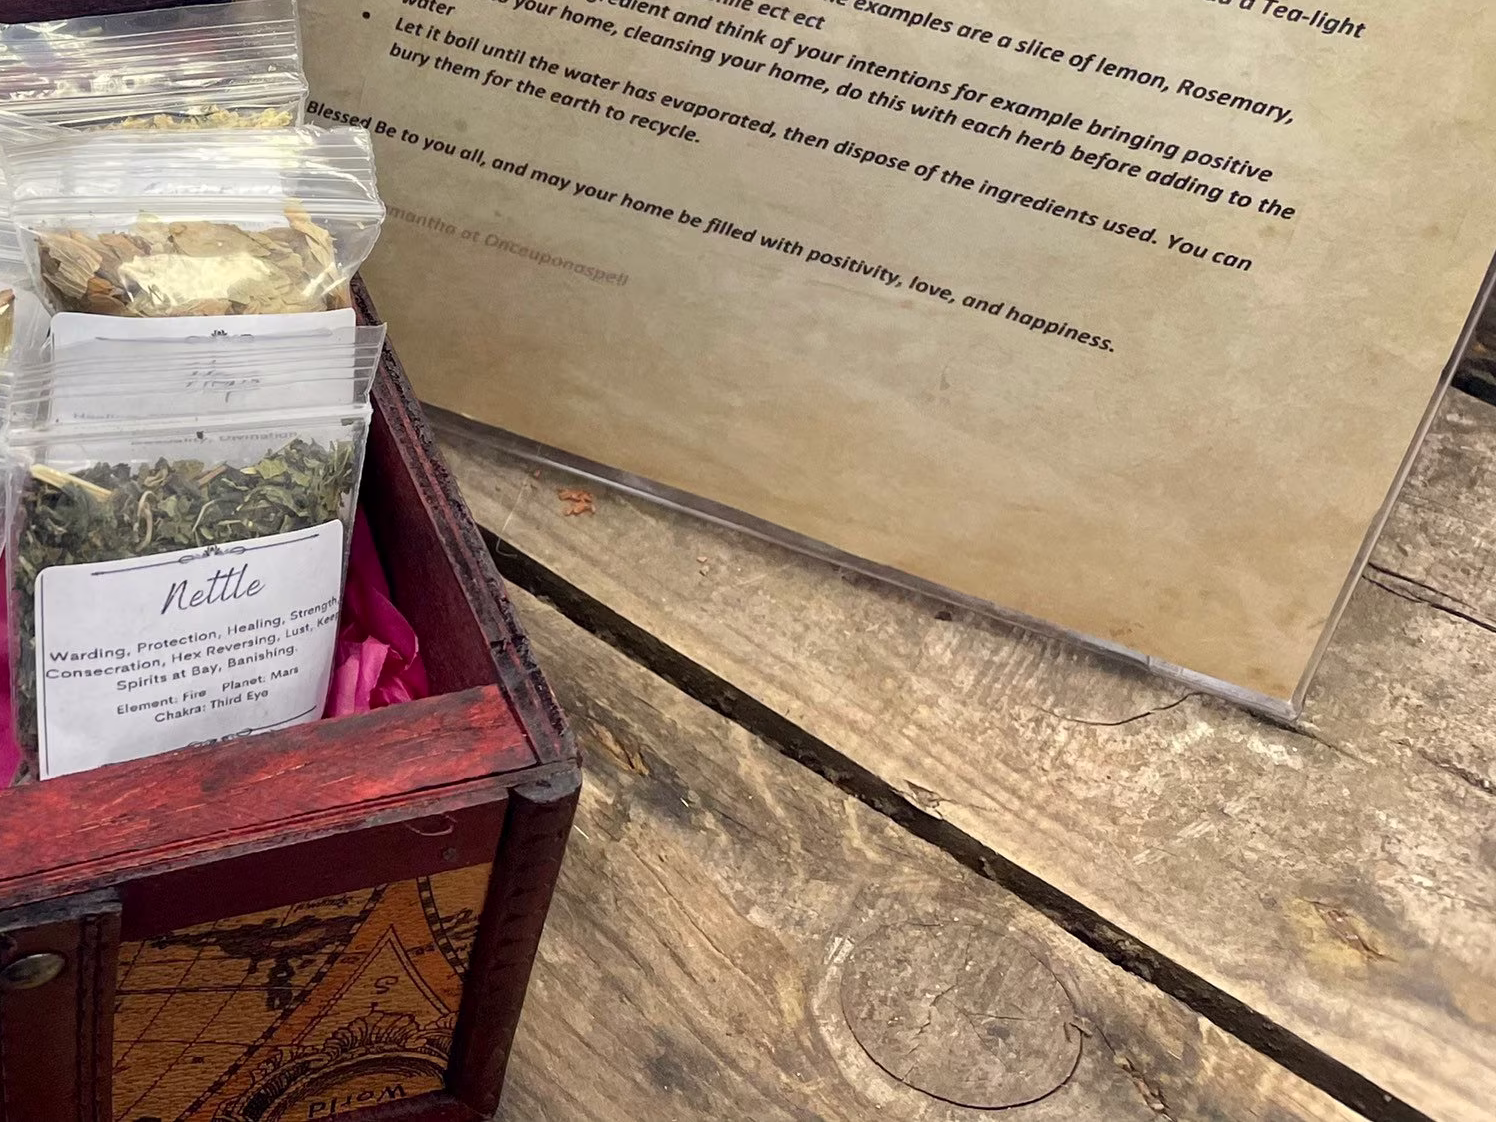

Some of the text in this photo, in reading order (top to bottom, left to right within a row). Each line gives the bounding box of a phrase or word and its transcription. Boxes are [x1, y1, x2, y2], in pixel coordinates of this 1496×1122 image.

[160, 564, 266, 615] Nettle
[172, 651, 202, 663] Hex
[116, 675, 167, 692] Spirits
[172, 669, 186, 680] at
[270, 666, 299, 681] Mars
[210, 693, 242, 709] Third
[308, 1084, 406, 1118] World
